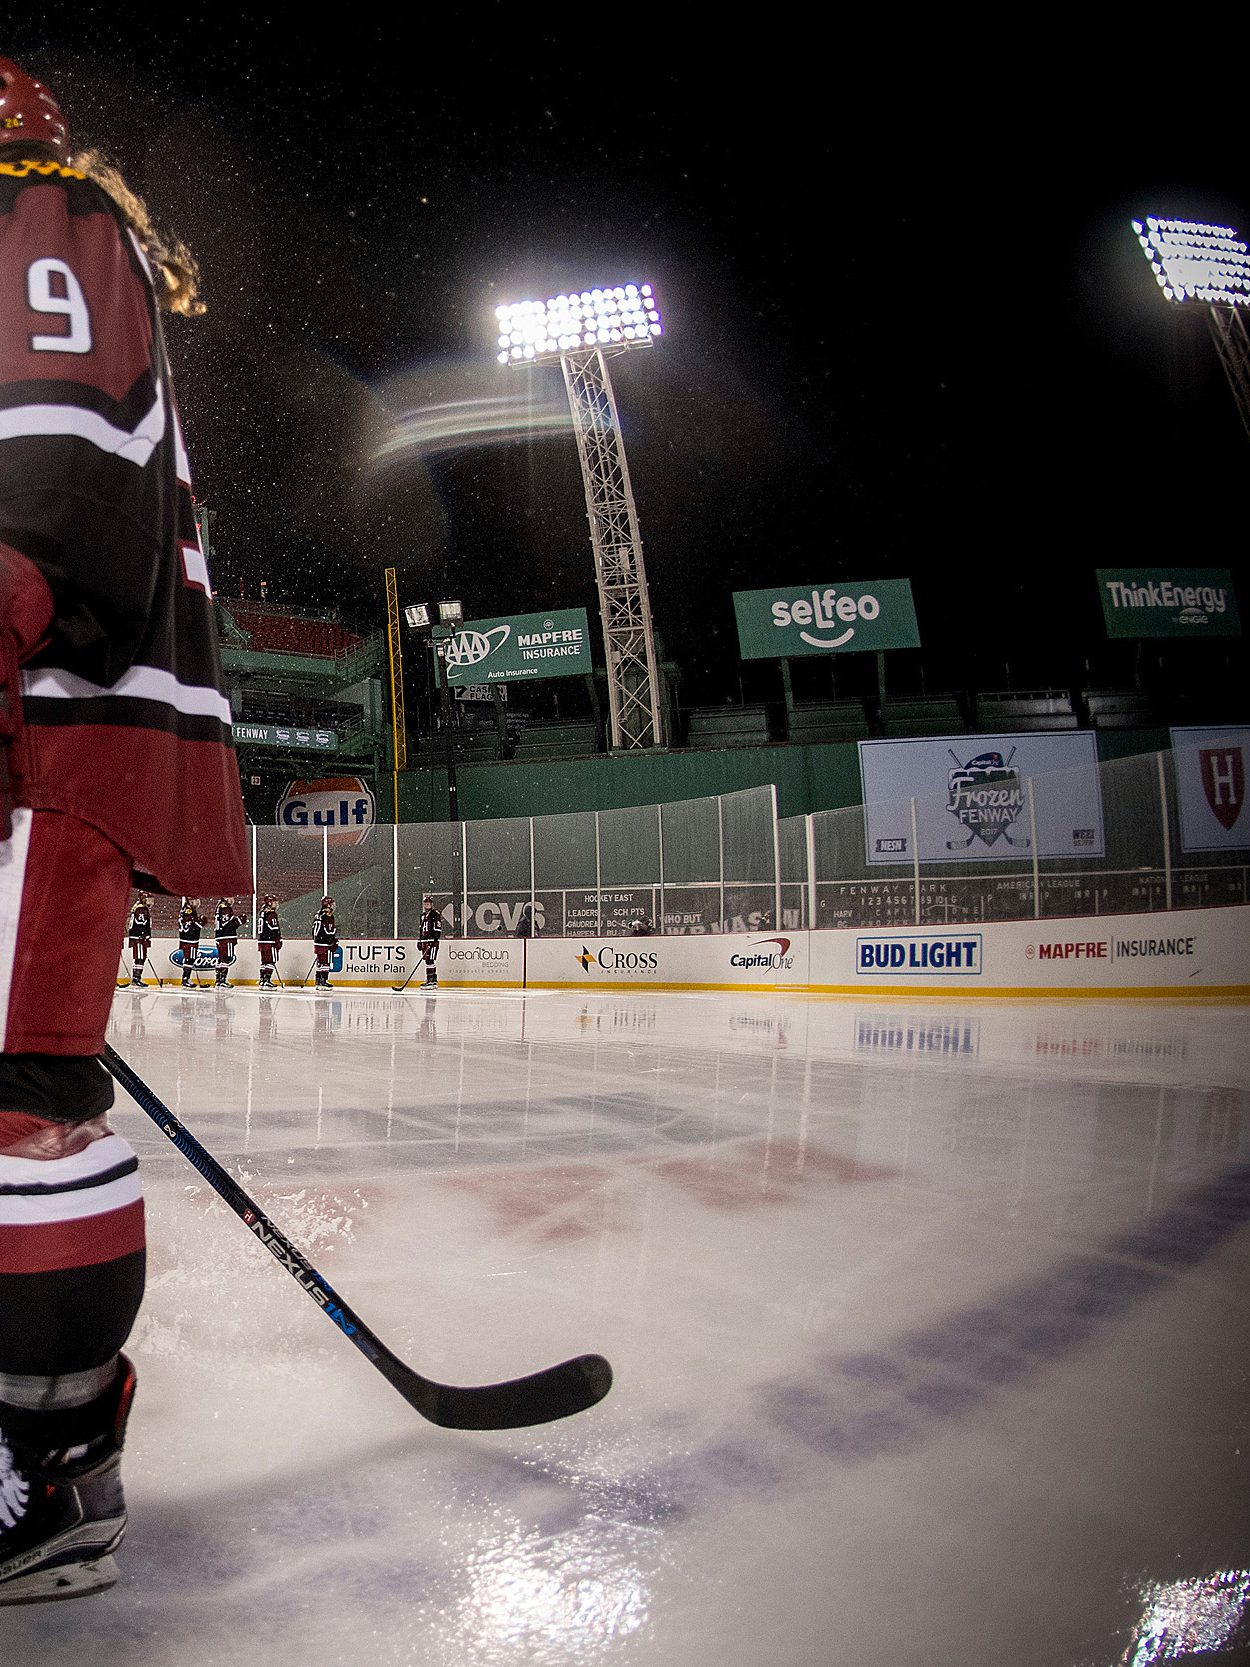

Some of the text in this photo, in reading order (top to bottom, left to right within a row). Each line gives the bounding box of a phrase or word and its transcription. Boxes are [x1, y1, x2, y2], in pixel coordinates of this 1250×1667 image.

[27, 257, 93, 354] 9
[517, 629, 583, 646] MAPFRE
[523, 646, 581, 660] INSURANCE
[487, 668, 538, 679] Auto Insurance
[236, 727, 268, 740] FENWAY
[946, 776, 1025, 811] Frozen
[283, 799, 369, 827] Gulf
[959, 808, 1019, 824] FENWAY
[584, 893, 634, 903] HOCKEY EAST
[476, 901, 546, 932] CVS
[567, 907, 645, 917] LEADERS SCH PTS
[683, 912, 703, 924] BUT
[346, 946, 406, 961] TUFTS
[448, 945, 509, 961] beantown
[860, 941, 977, 968] BUD LIGHT
[1039, 938, 1194, 960] MAPFRE INSURANCE
[598, 946, 658, 970] CROSS
[346, 963, 406, 974] Health Plan
[251, 1220, 331, 1306] NEXUS
